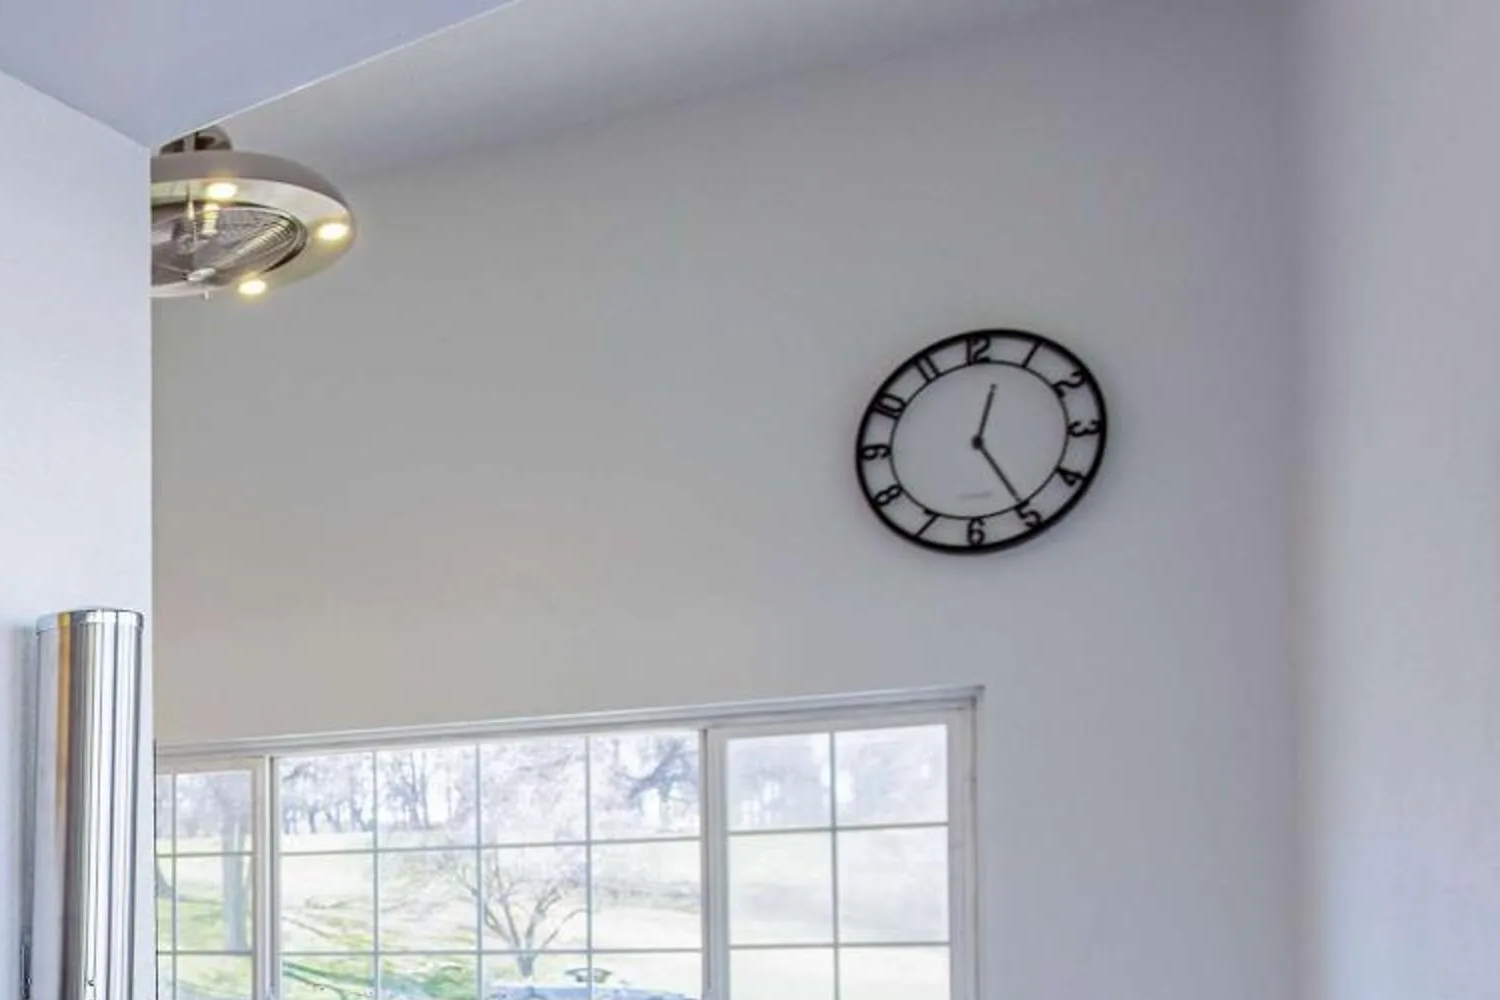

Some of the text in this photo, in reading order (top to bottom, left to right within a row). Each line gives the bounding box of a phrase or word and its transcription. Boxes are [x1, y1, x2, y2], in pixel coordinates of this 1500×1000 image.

[965, 334, 991, 365] 12
[1051, 368, 1088, 399] 2
[1066, 419, 1101, 438] 3
[860, 443, 892, 461] 9
[1056, 465, 1088, 487] 4
[873, 483, 902, 507] 8
[1014, 499, 1042, 528] 5
[966, 516, 985, 546] 6
